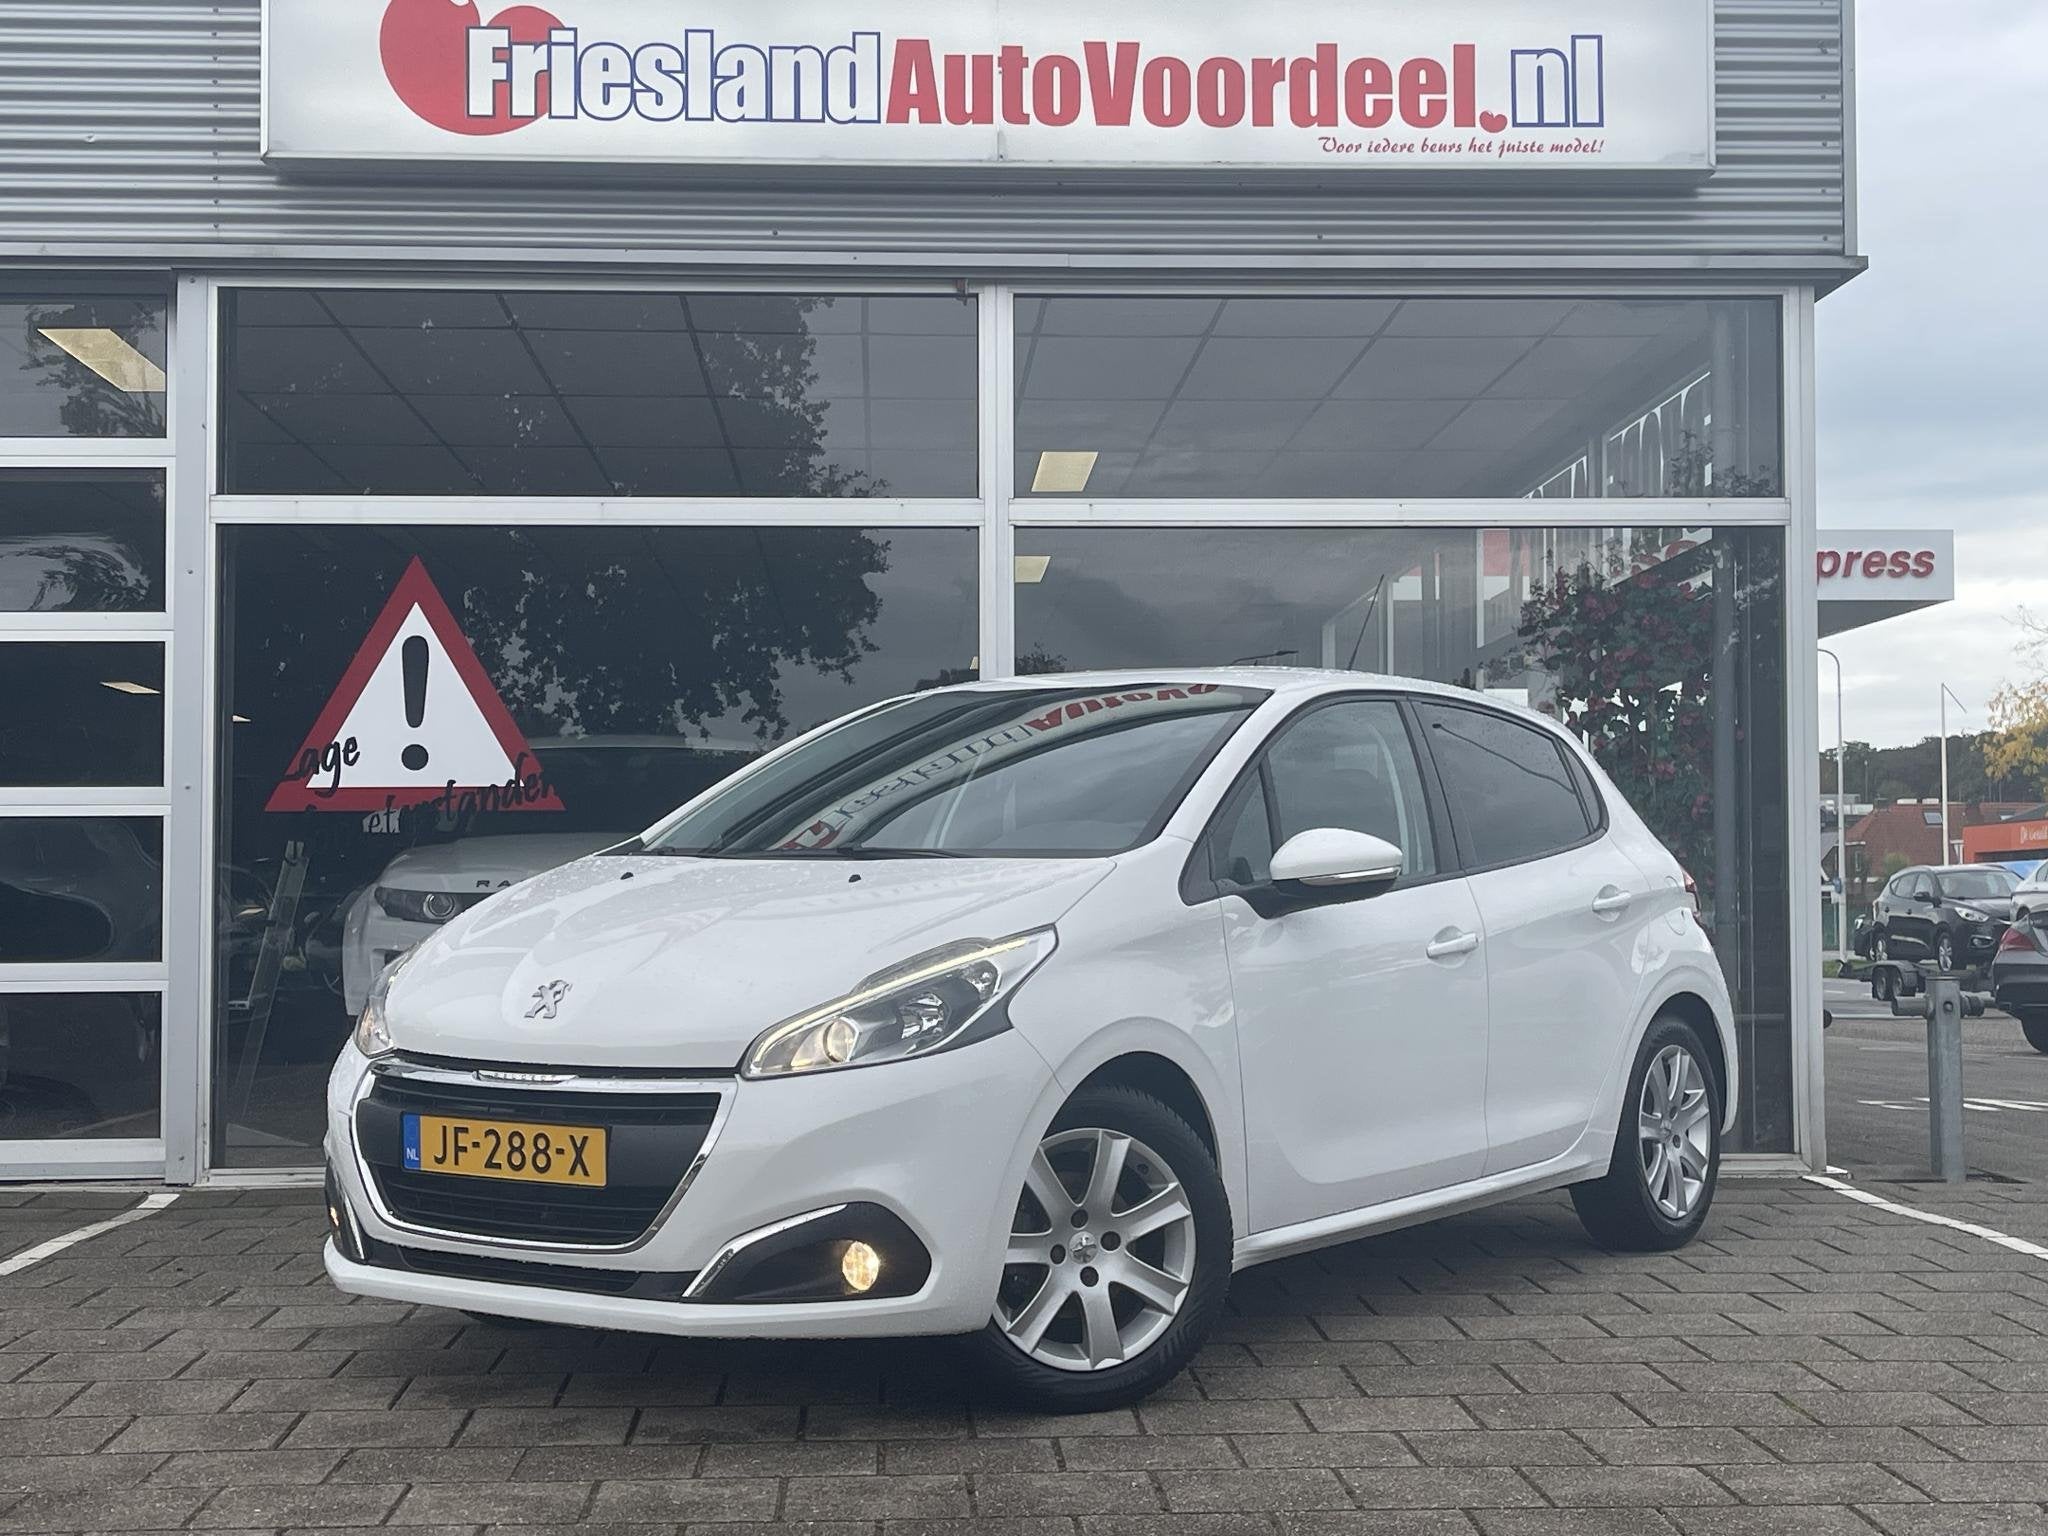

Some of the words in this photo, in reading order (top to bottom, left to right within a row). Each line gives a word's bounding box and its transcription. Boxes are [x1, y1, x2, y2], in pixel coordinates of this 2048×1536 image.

[464, 27, 1605, 132] FrieslandAutoVoordeel.nl
[1318, 136, 1363, 153] Voor
[1367, 139, 1415, 153] iedere
[1420, 136, 1463, 153] beurs
[1468, 136, 1493, 153] het
[1497, 140, 1545, 158] juiste
[1549, 137, 1605, 153] model!
[1816, 550, 1936, 588] press
[406, 1147, 419, 1161] NL
[433, 1125, 590, 1178] JF-288-X
